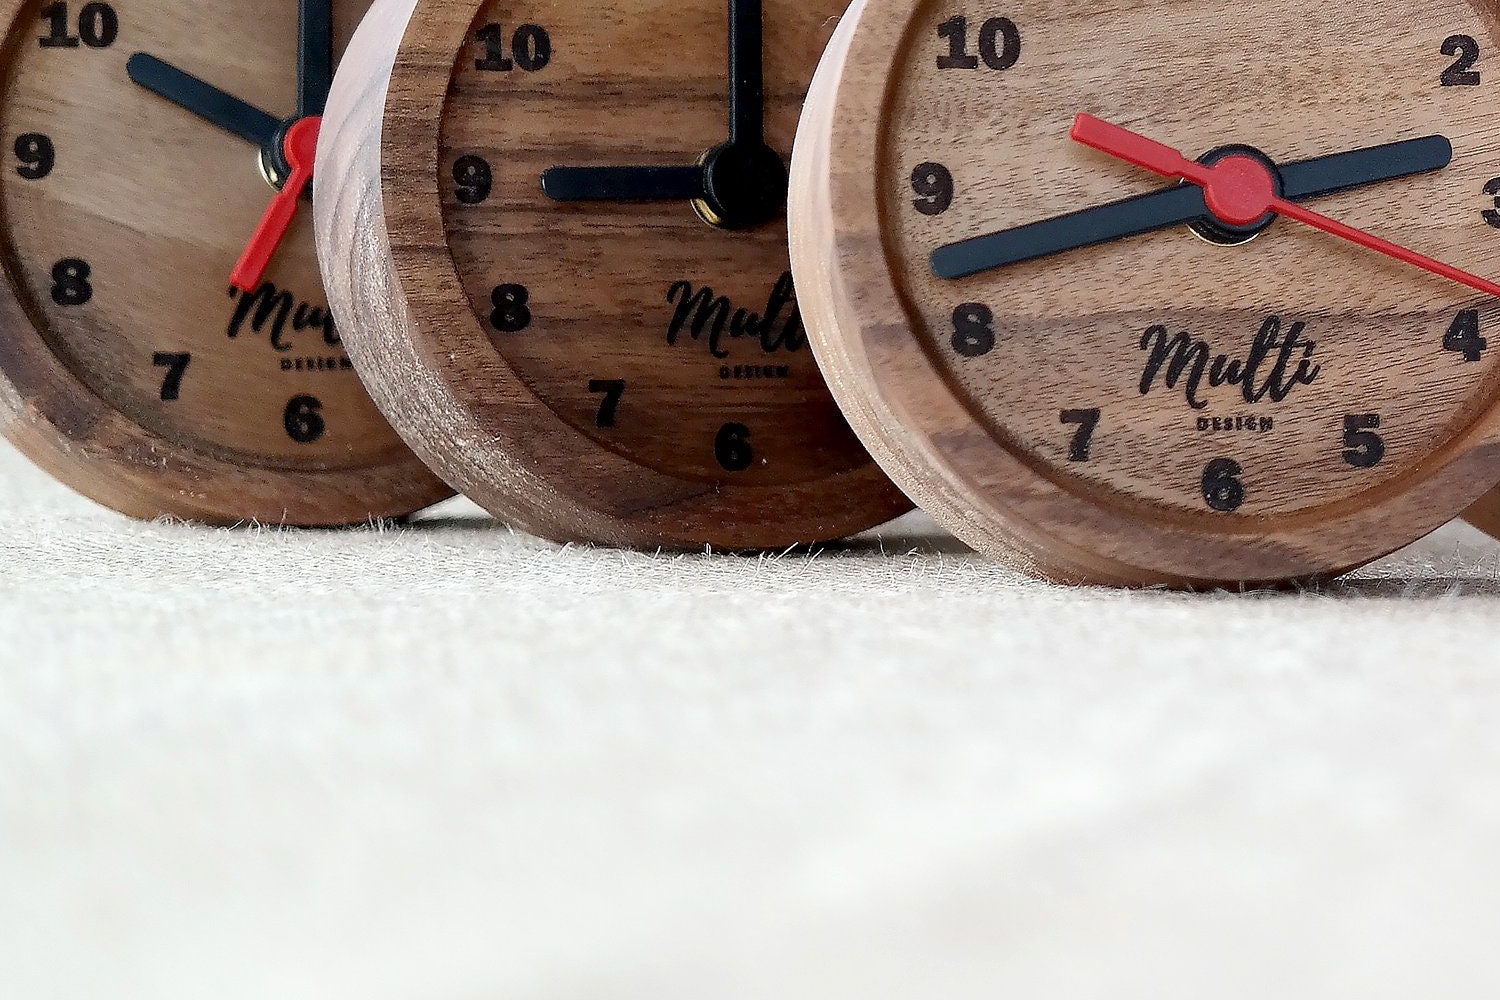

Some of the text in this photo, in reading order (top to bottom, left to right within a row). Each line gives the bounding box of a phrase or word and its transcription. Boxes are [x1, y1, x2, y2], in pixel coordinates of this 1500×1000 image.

[38, 1, 118, 48] 10
[475, 24, 552, 72] 10
[937, 15, 1021, 71] 10
[1440, 35, 1480, 86] 2
[13, 133, 55, 180] 9
[452, 155, 492, 204] 9
[911, 162, 954, 215] 9
[50, 259, 92, 307] 8
[490, 283, 531, 333] 8
[951, 303, 995, 357] 8
[1443, 308, 1487, 362] 4
[153, 352, 191, 401] 7
[1140, 315, 1320, 409] Multi
[284, 395, 324, 443] 6
[589, 380, 625, 428] 7
[1197, 417, 1273, 432] DESIGN
[715, 423, 754, 471] 6
[1060, 408, 1100, 462] 7
[1342, 414, 1385, 468] 5
[1201, 458, 1246, 512] 6
